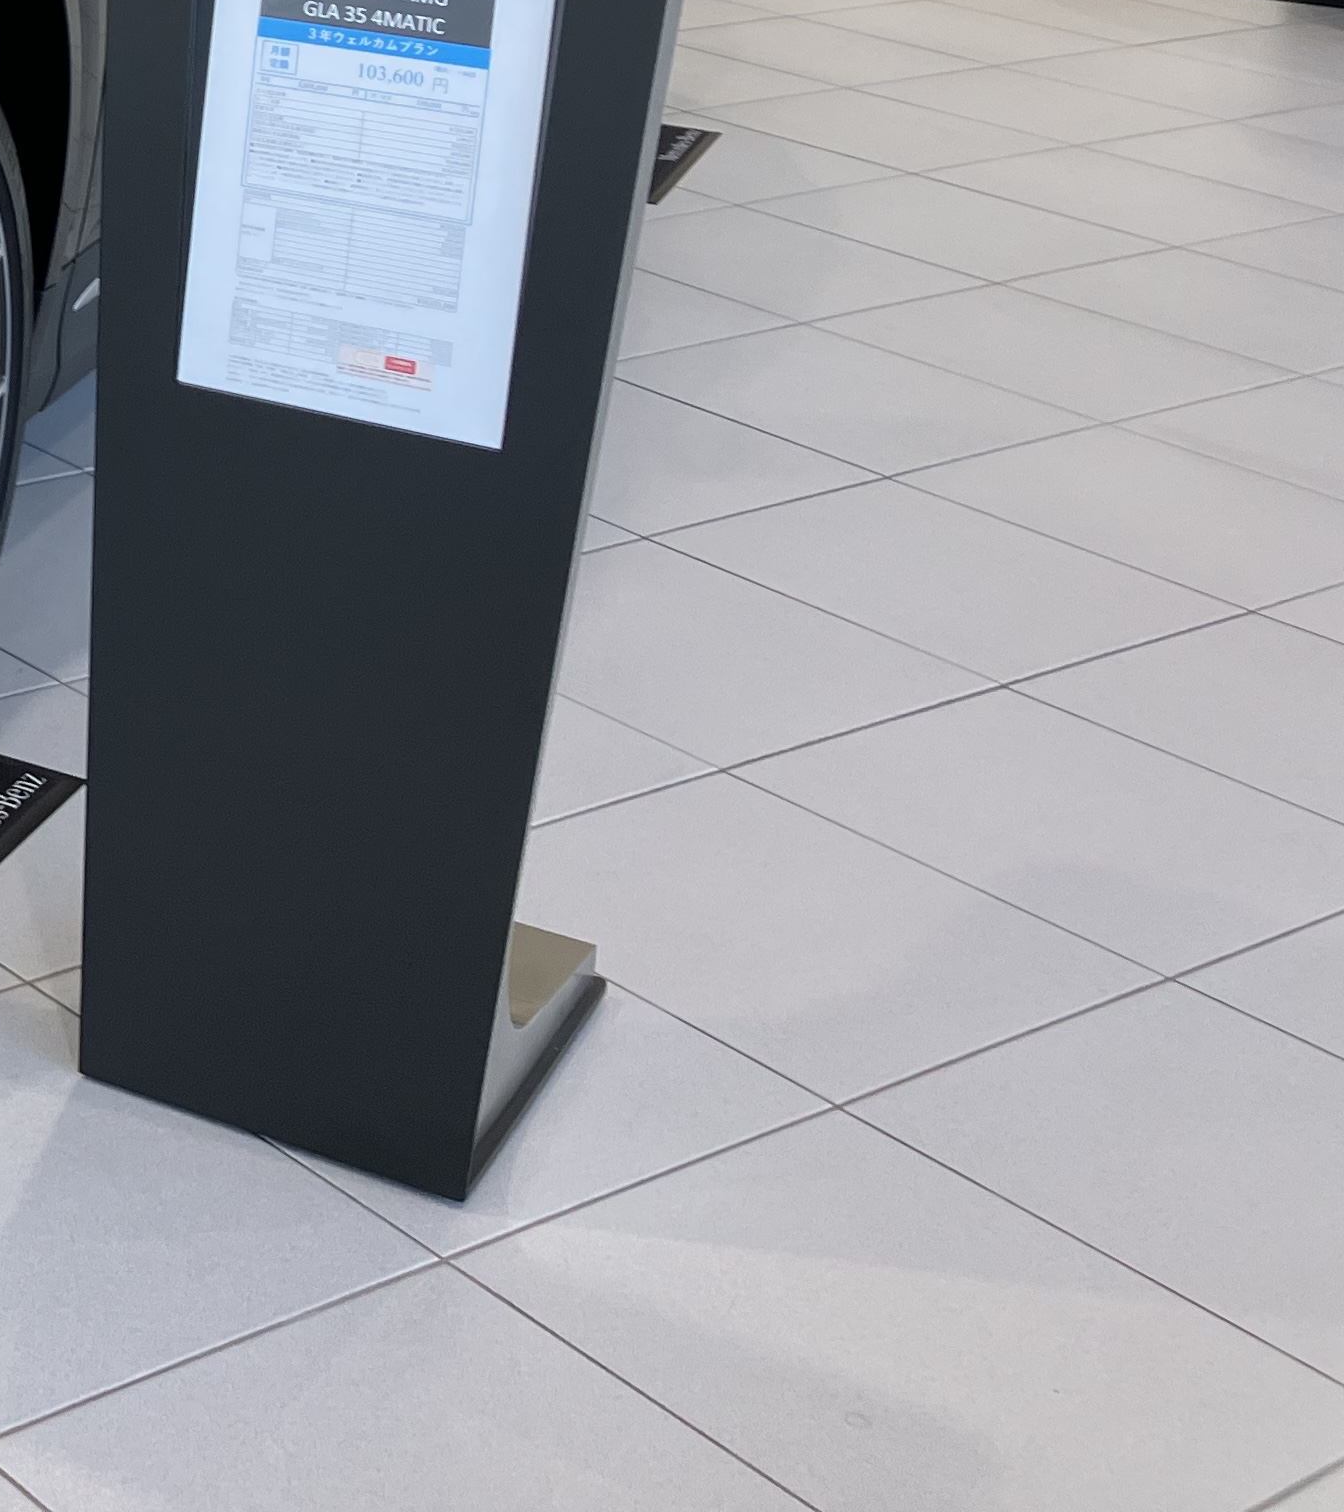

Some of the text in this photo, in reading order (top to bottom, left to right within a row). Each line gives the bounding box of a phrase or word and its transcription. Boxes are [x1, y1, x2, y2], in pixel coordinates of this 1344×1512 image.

[302, 0, 447, 35] GLA 35 4MATIC
[357, 62, 424, 88] 103,600
